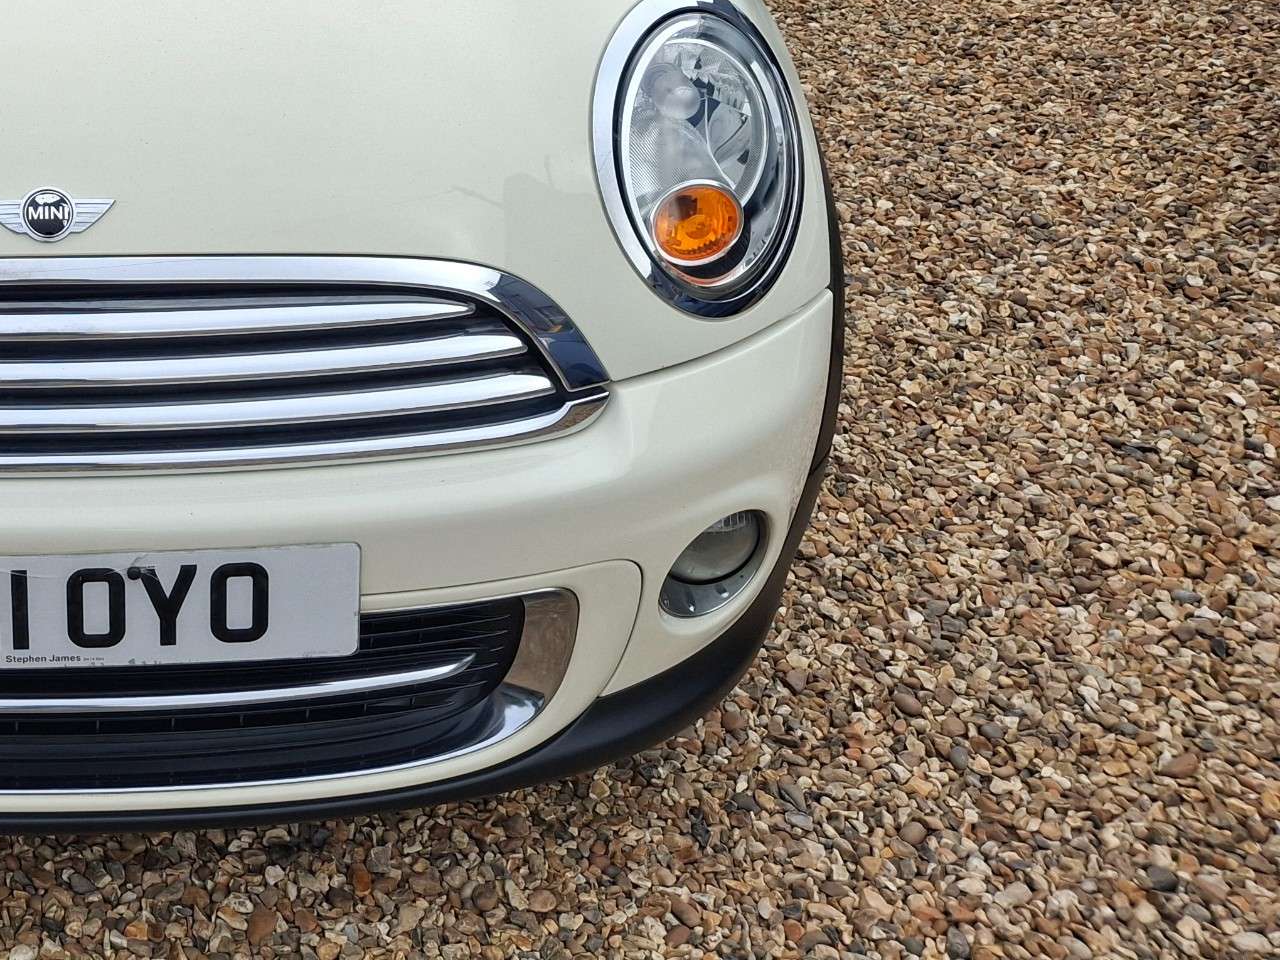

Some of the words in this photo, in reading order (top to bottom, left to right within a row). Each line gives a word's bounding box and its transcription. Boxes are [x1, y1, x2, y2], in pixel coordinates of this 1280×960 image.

[28, 205, 69, 220] MINI
[5, 655, 47, 664] Stephen
[49, 654, 81, 663] James
